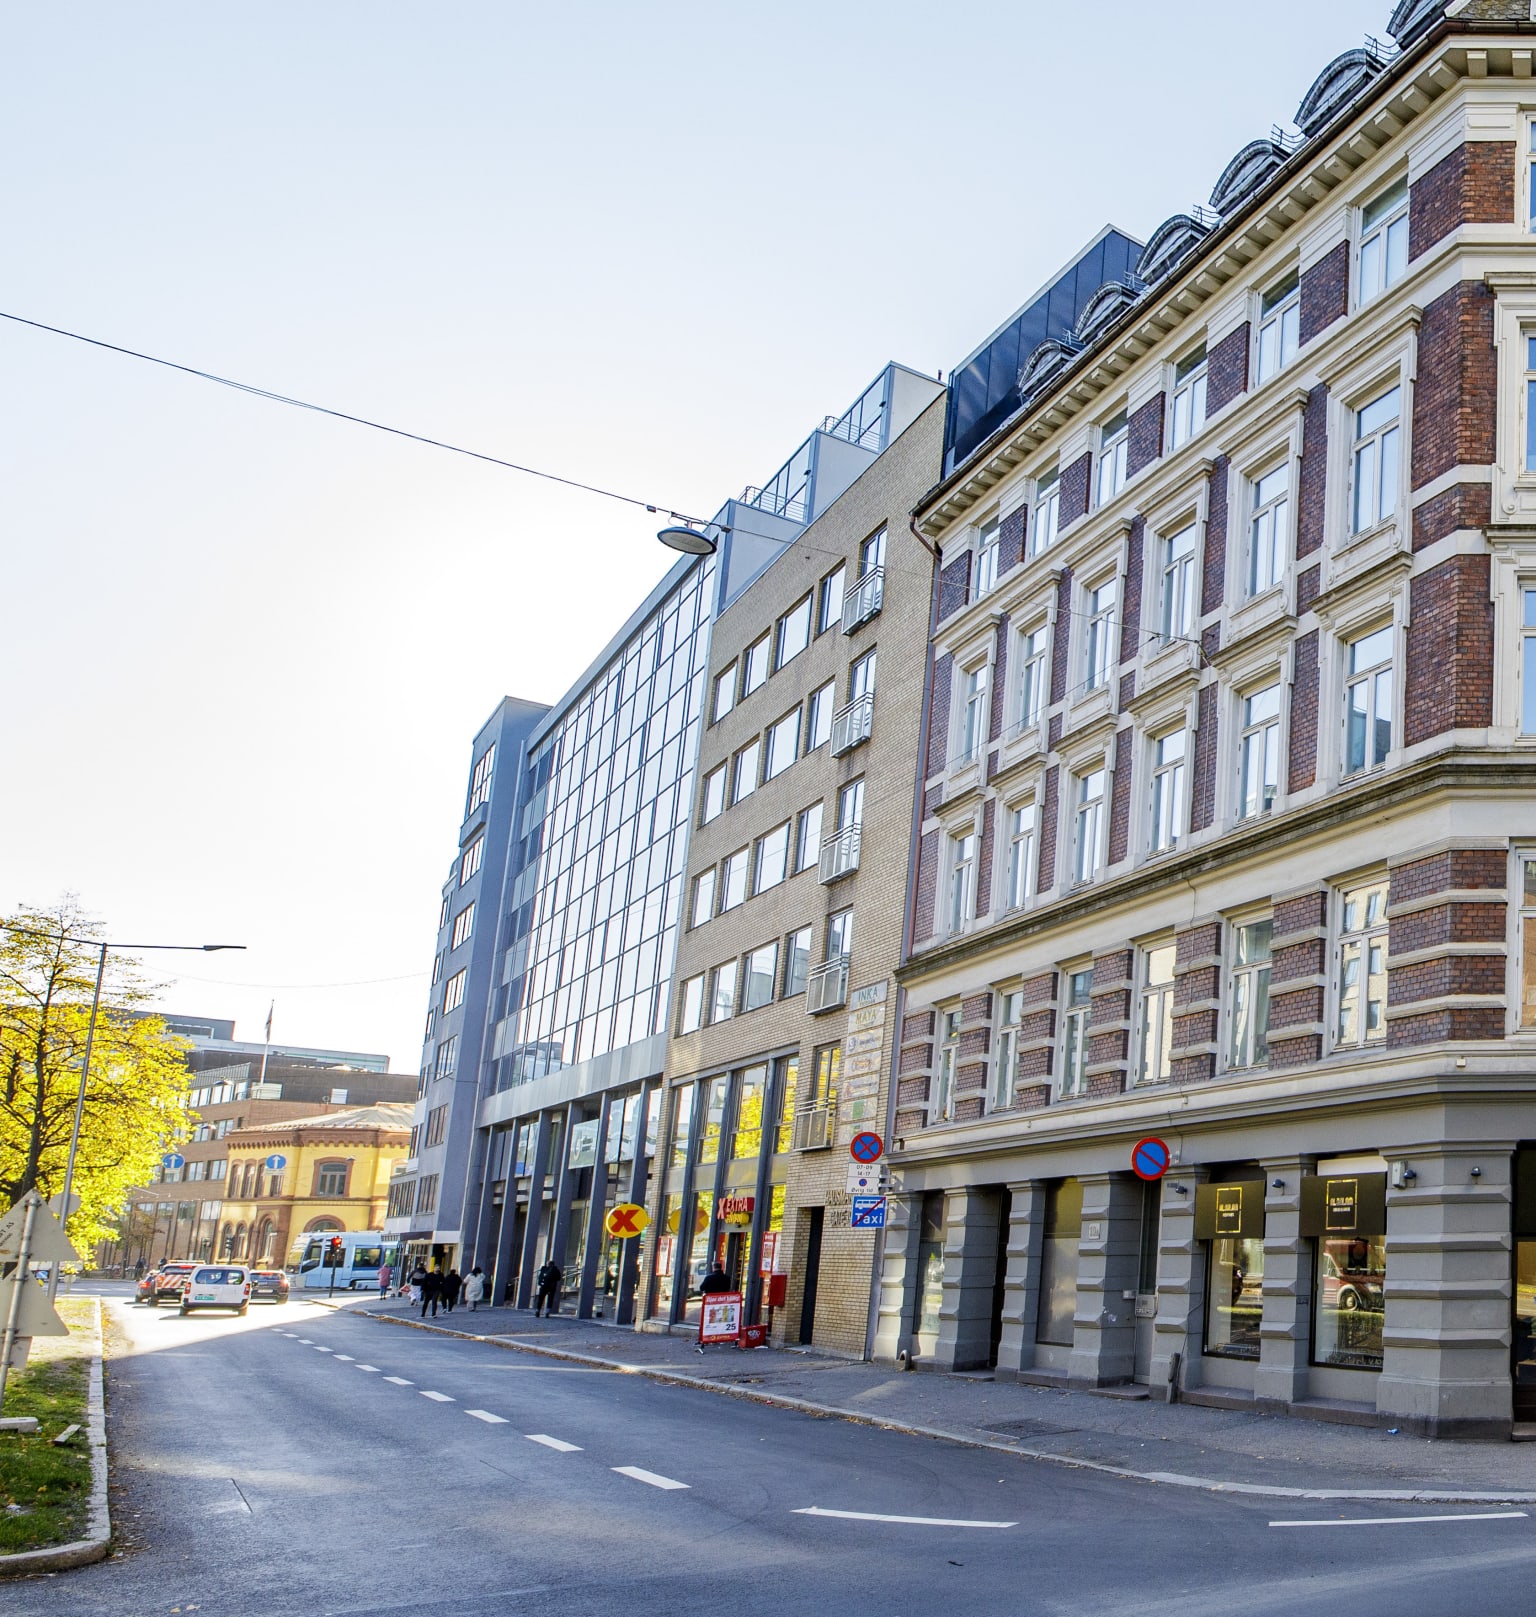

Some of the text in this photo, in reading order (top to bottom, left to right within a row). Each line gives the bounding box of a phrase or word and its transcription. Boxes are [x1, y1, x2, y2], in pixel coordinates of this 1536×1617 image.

[858, 986, 878, 1003] INKA
[855, 1009, 877, 1025] MAYA
[726, 1197, 748, 1212] EXTRA
[854, 1212, 883, 1225] Taxi
[726, 1323, 737, 1331] 25
